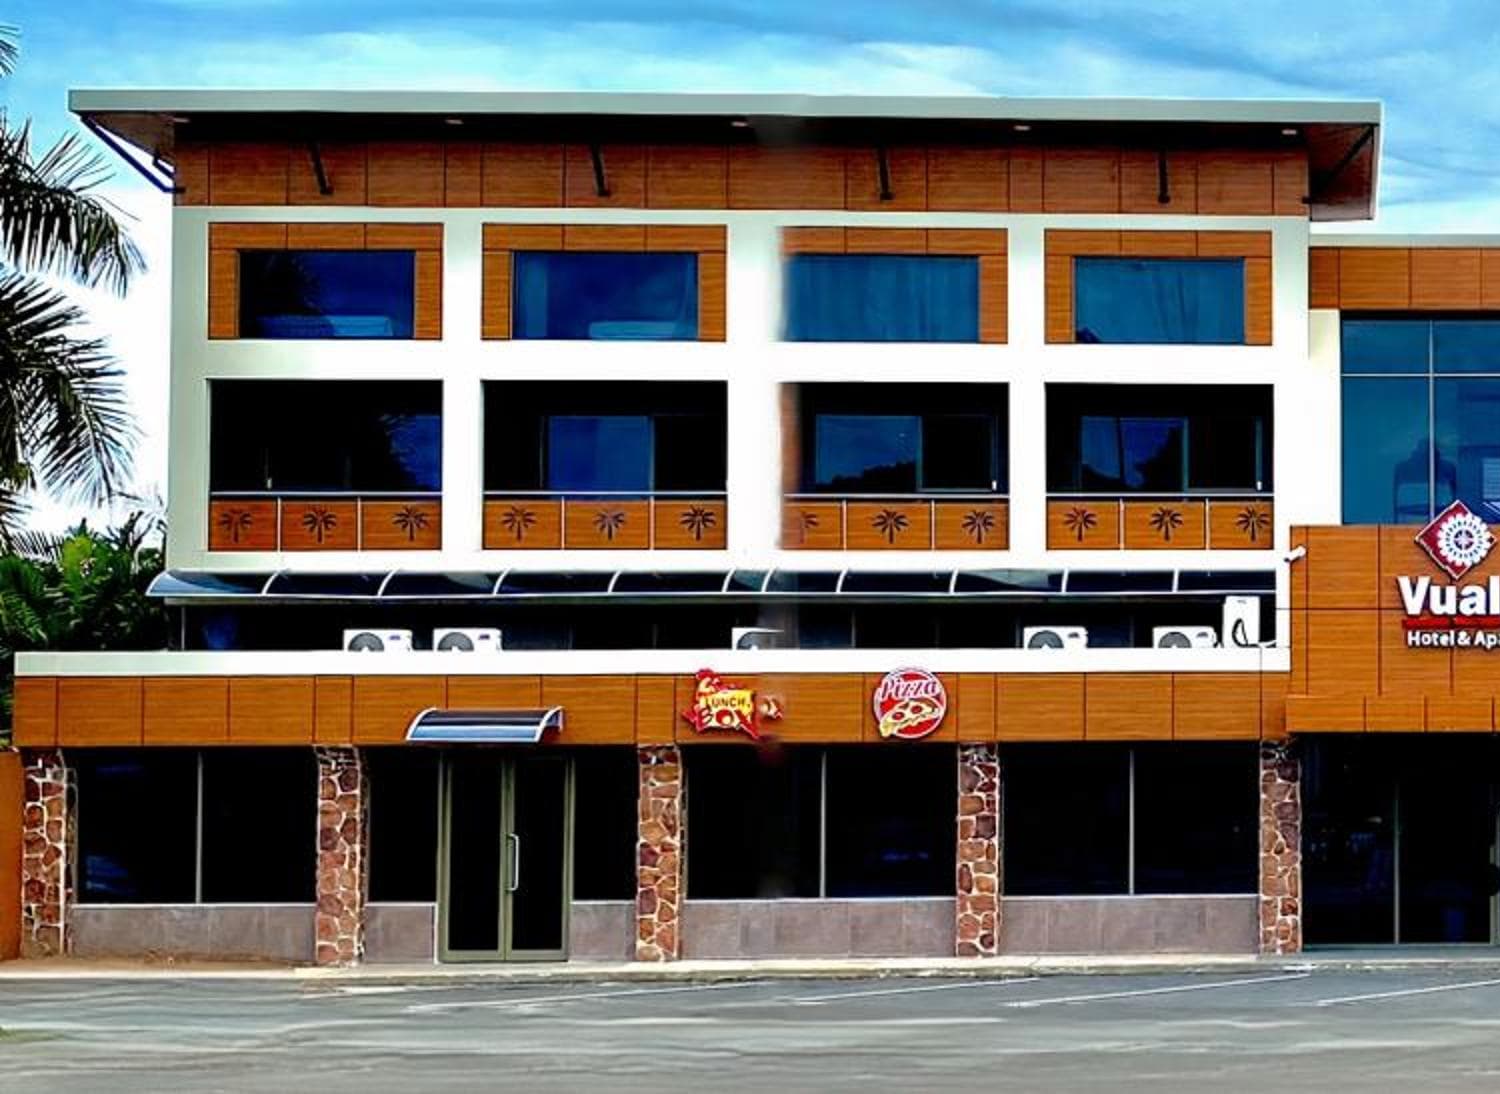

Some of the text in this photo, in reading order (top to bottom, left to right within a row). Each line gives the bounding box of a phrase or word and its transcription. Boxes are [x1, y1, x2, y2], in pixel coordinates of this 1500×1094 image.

[1407, 631, 1455, 647] Hotel
[1457, 631, 1471, 647] &
[881, 678, 940, 700] Pizza
